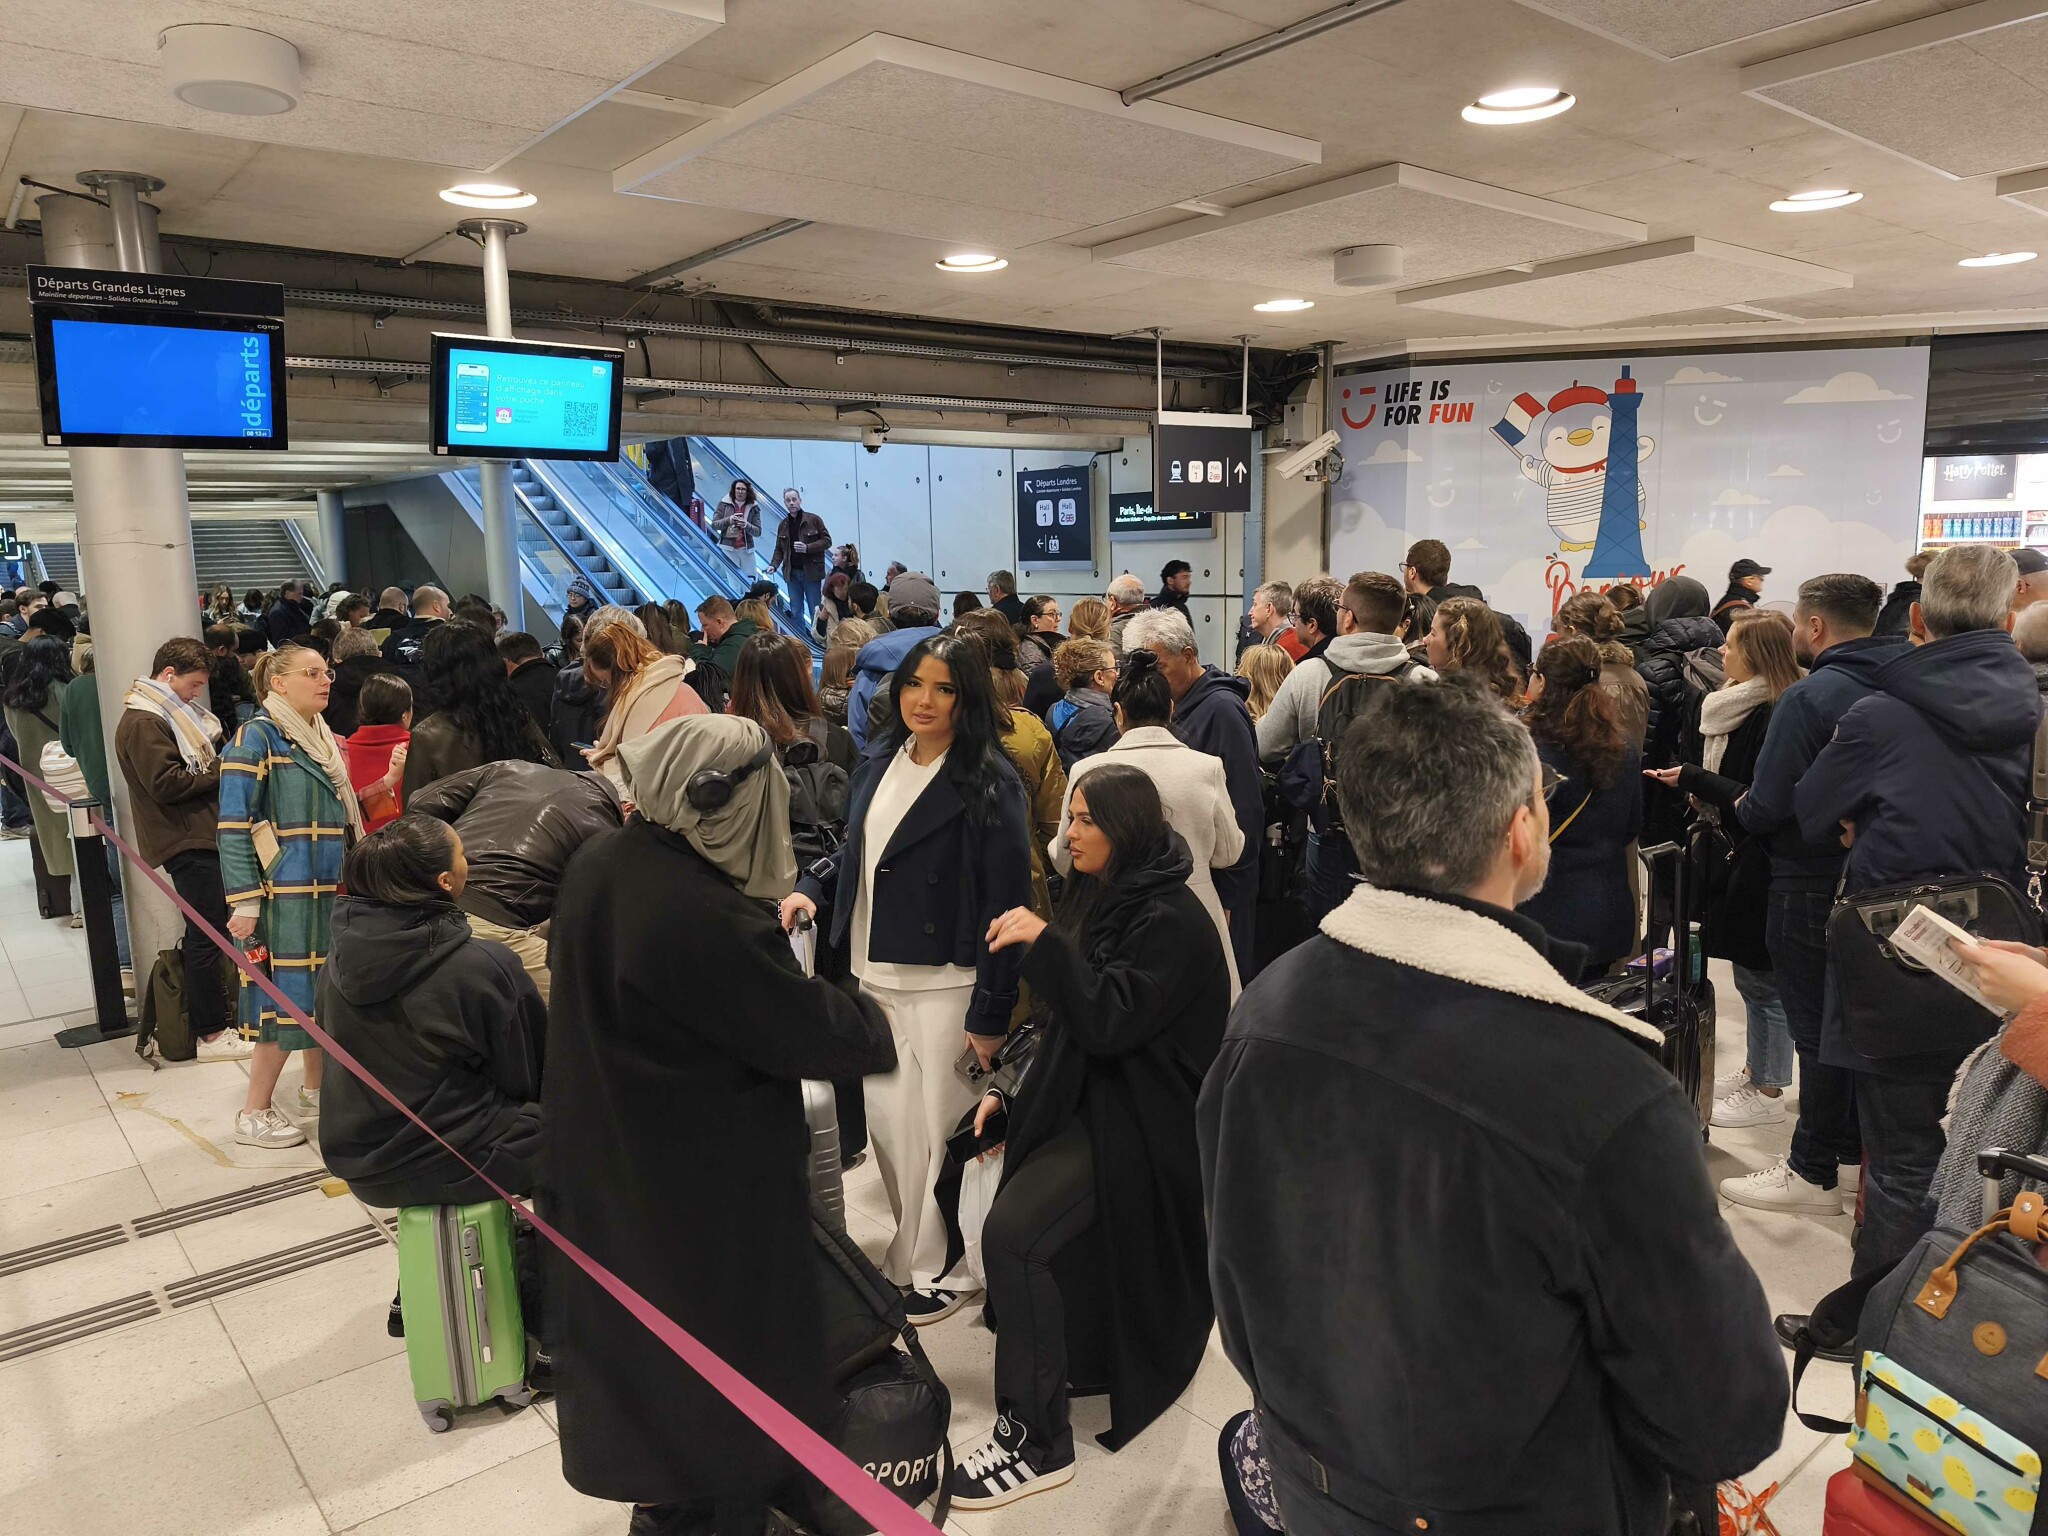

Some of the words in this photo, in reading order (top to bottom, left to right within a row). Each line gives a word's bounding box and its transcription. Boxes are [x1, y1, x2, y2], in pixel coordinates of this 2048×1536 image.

[37, 276, 89, 291] Départs
[92, 280, 144, 294] Grandes
[147, 284, 186, 299] Lignes
[38, 291, 67, 299] Mainline
[68, 292, 103, 301] departures
[108, 295, 131, 303] Salidas
[132, 297, 158, 305] Grandes
[240, 336, 267, 427] départs
[496, 374, 537, 386] Retrouvez
[551, 379, 585, 389] panneau
[544, 387, 563, 396] dans
[1384, 381, 1423, 404] LIFE
[1429, 380, 1451, 401] IS
[496, 395, 517, 403] votre
[519, 395, 545, 405] poche
[1383, 404, 1422, 427] FOR
[1428, 402, 1474, 424] FUN
[1943, 463, 1973, 481] Harry
[1973, 461, 2005, 480] Potter
[1036, 479, 1056, 488] Départs
[1057, 477, 1077, 486] Londres
[1061, 502, 1072, 510] Hall
[1042, 513, 1047, 523] 1
[1060, 512, 1066, 522] 2
[862, 1454, 935, 1487] SPORT
